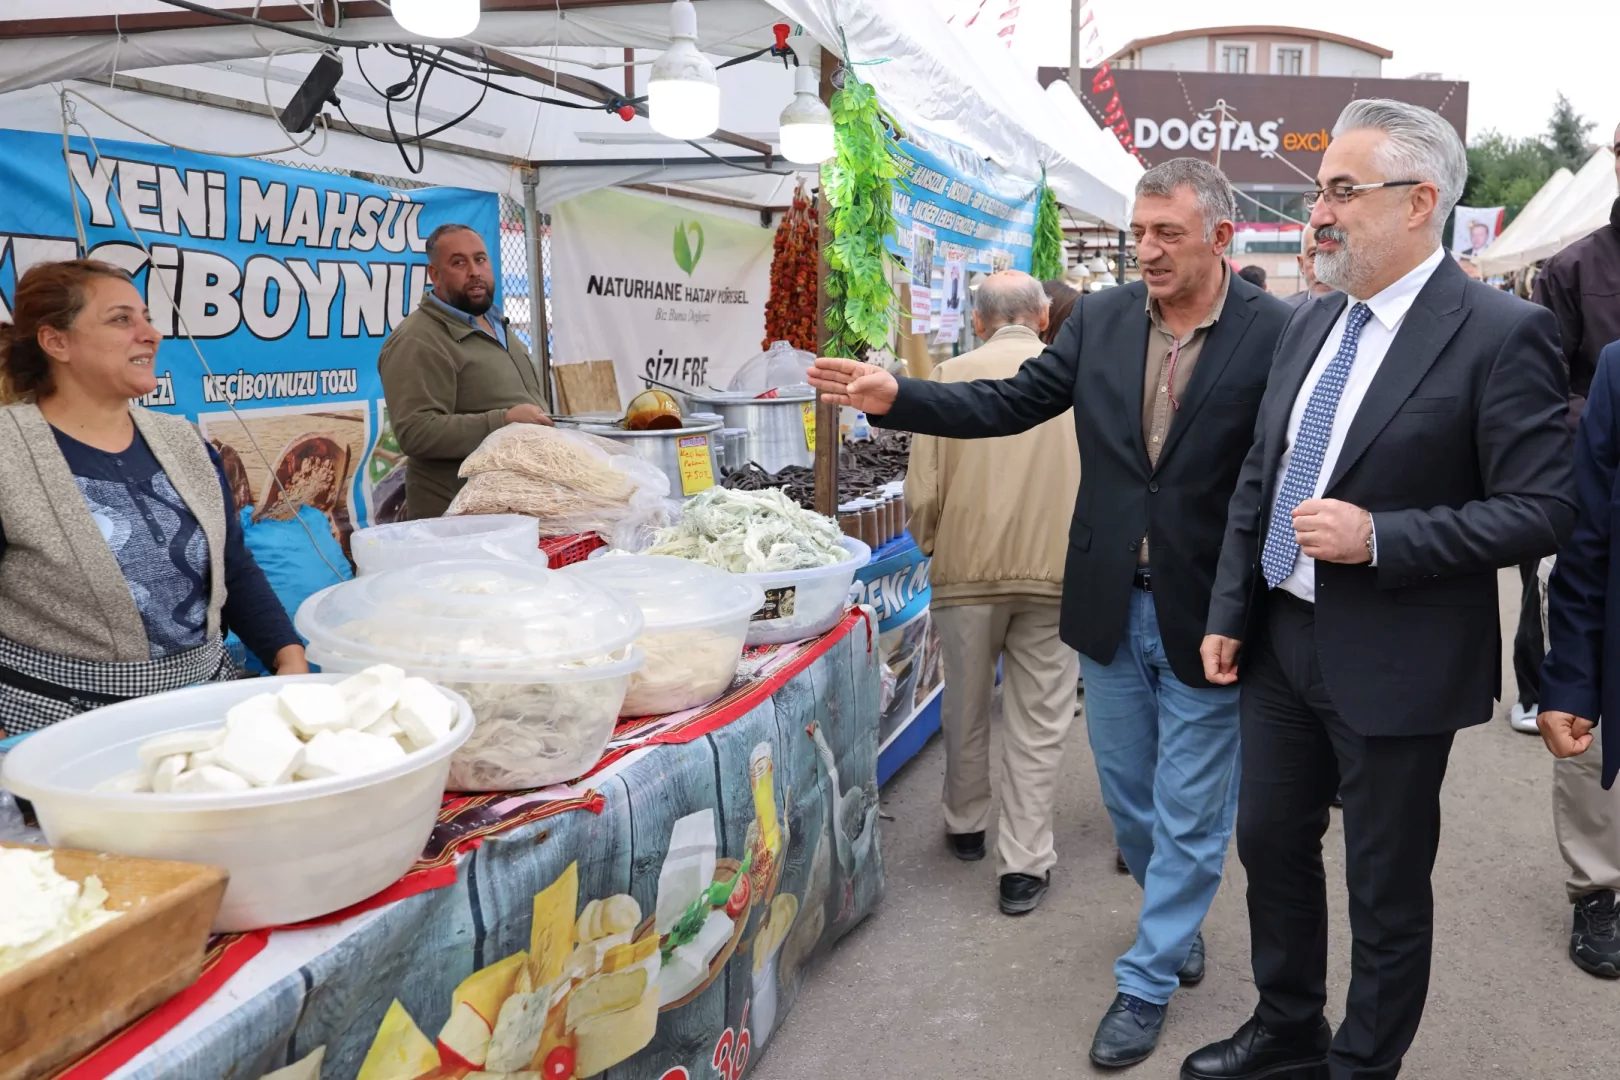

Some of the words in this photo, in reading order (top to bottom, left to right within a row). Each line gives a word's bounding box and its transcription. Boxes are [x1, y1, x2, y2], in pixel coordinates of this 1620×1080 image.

[1134, 113, 1279, 159] DOĞTAŞ
[1283, 128, 1328, 151] excl
[64, 149, 228, 240] YENİ
[239, 177, 429, 253] MAHSÜL
[586, 275, 683, 301] NATURHANE
[685, 287, 717, 304] HATAY
[203, 369, 318, 405] KEÇİBOYNUZU
[320, 369, 358, 394] TOZU
